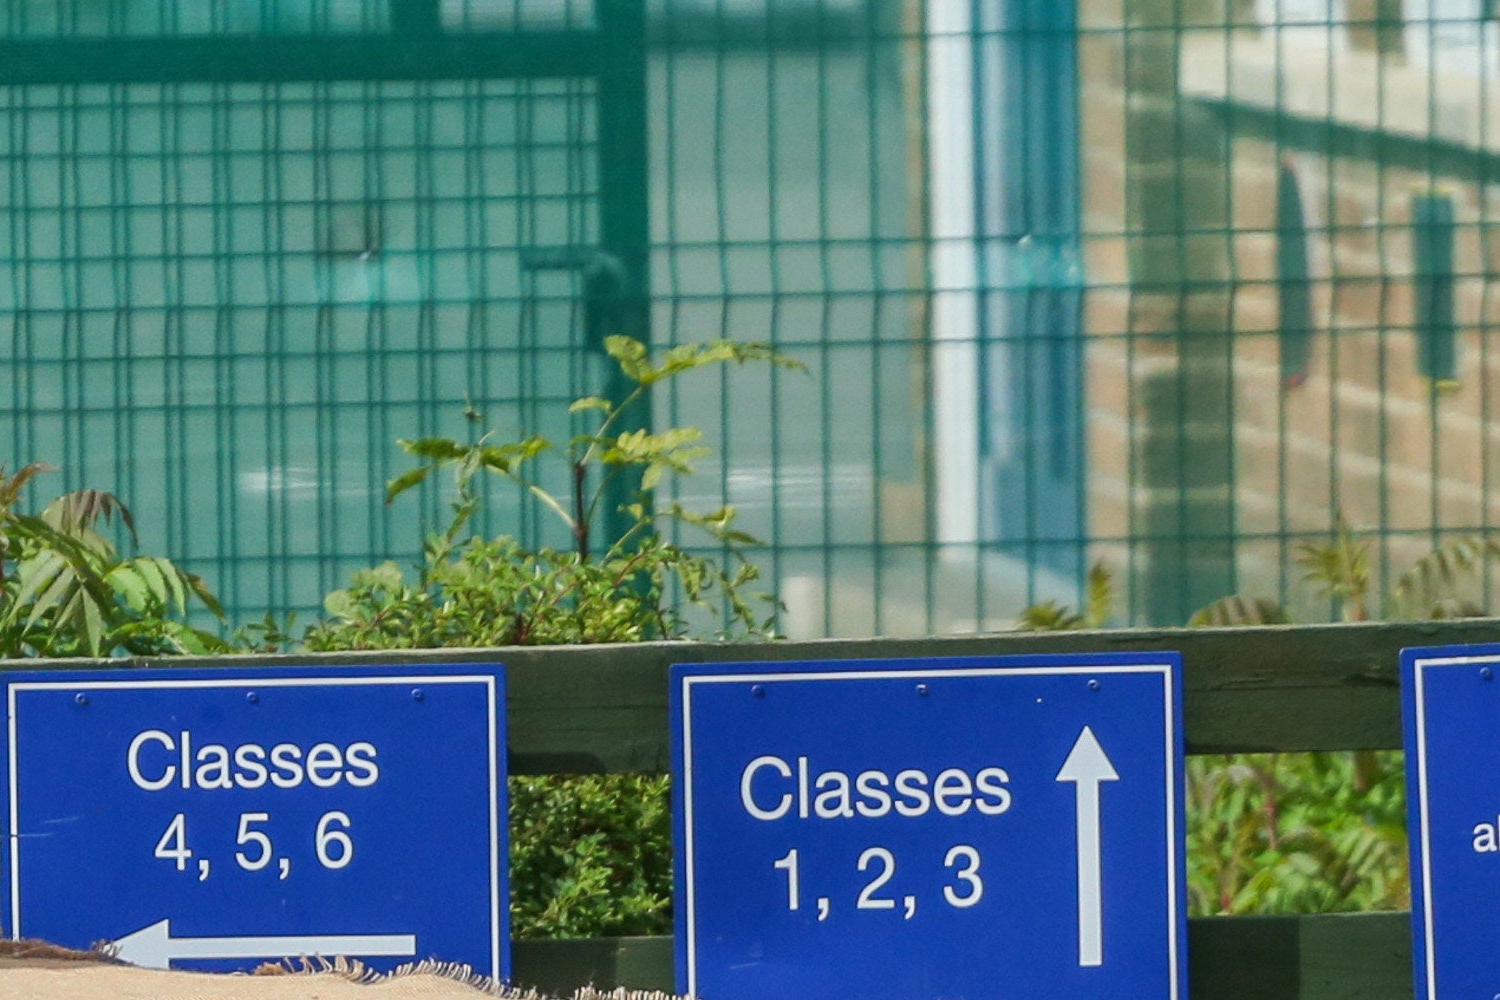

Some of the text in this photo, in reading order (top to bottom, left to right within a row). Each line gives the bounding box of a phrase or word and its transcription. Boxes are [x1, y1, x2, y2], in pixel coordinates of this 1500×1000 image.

[128, 730, 379, 790] Classes
[741, 756, 1012, 821] Classes
[154, 811, 353, 882] 4, 5, 6
[774, 845, 983, 922] 1, 2, 3
